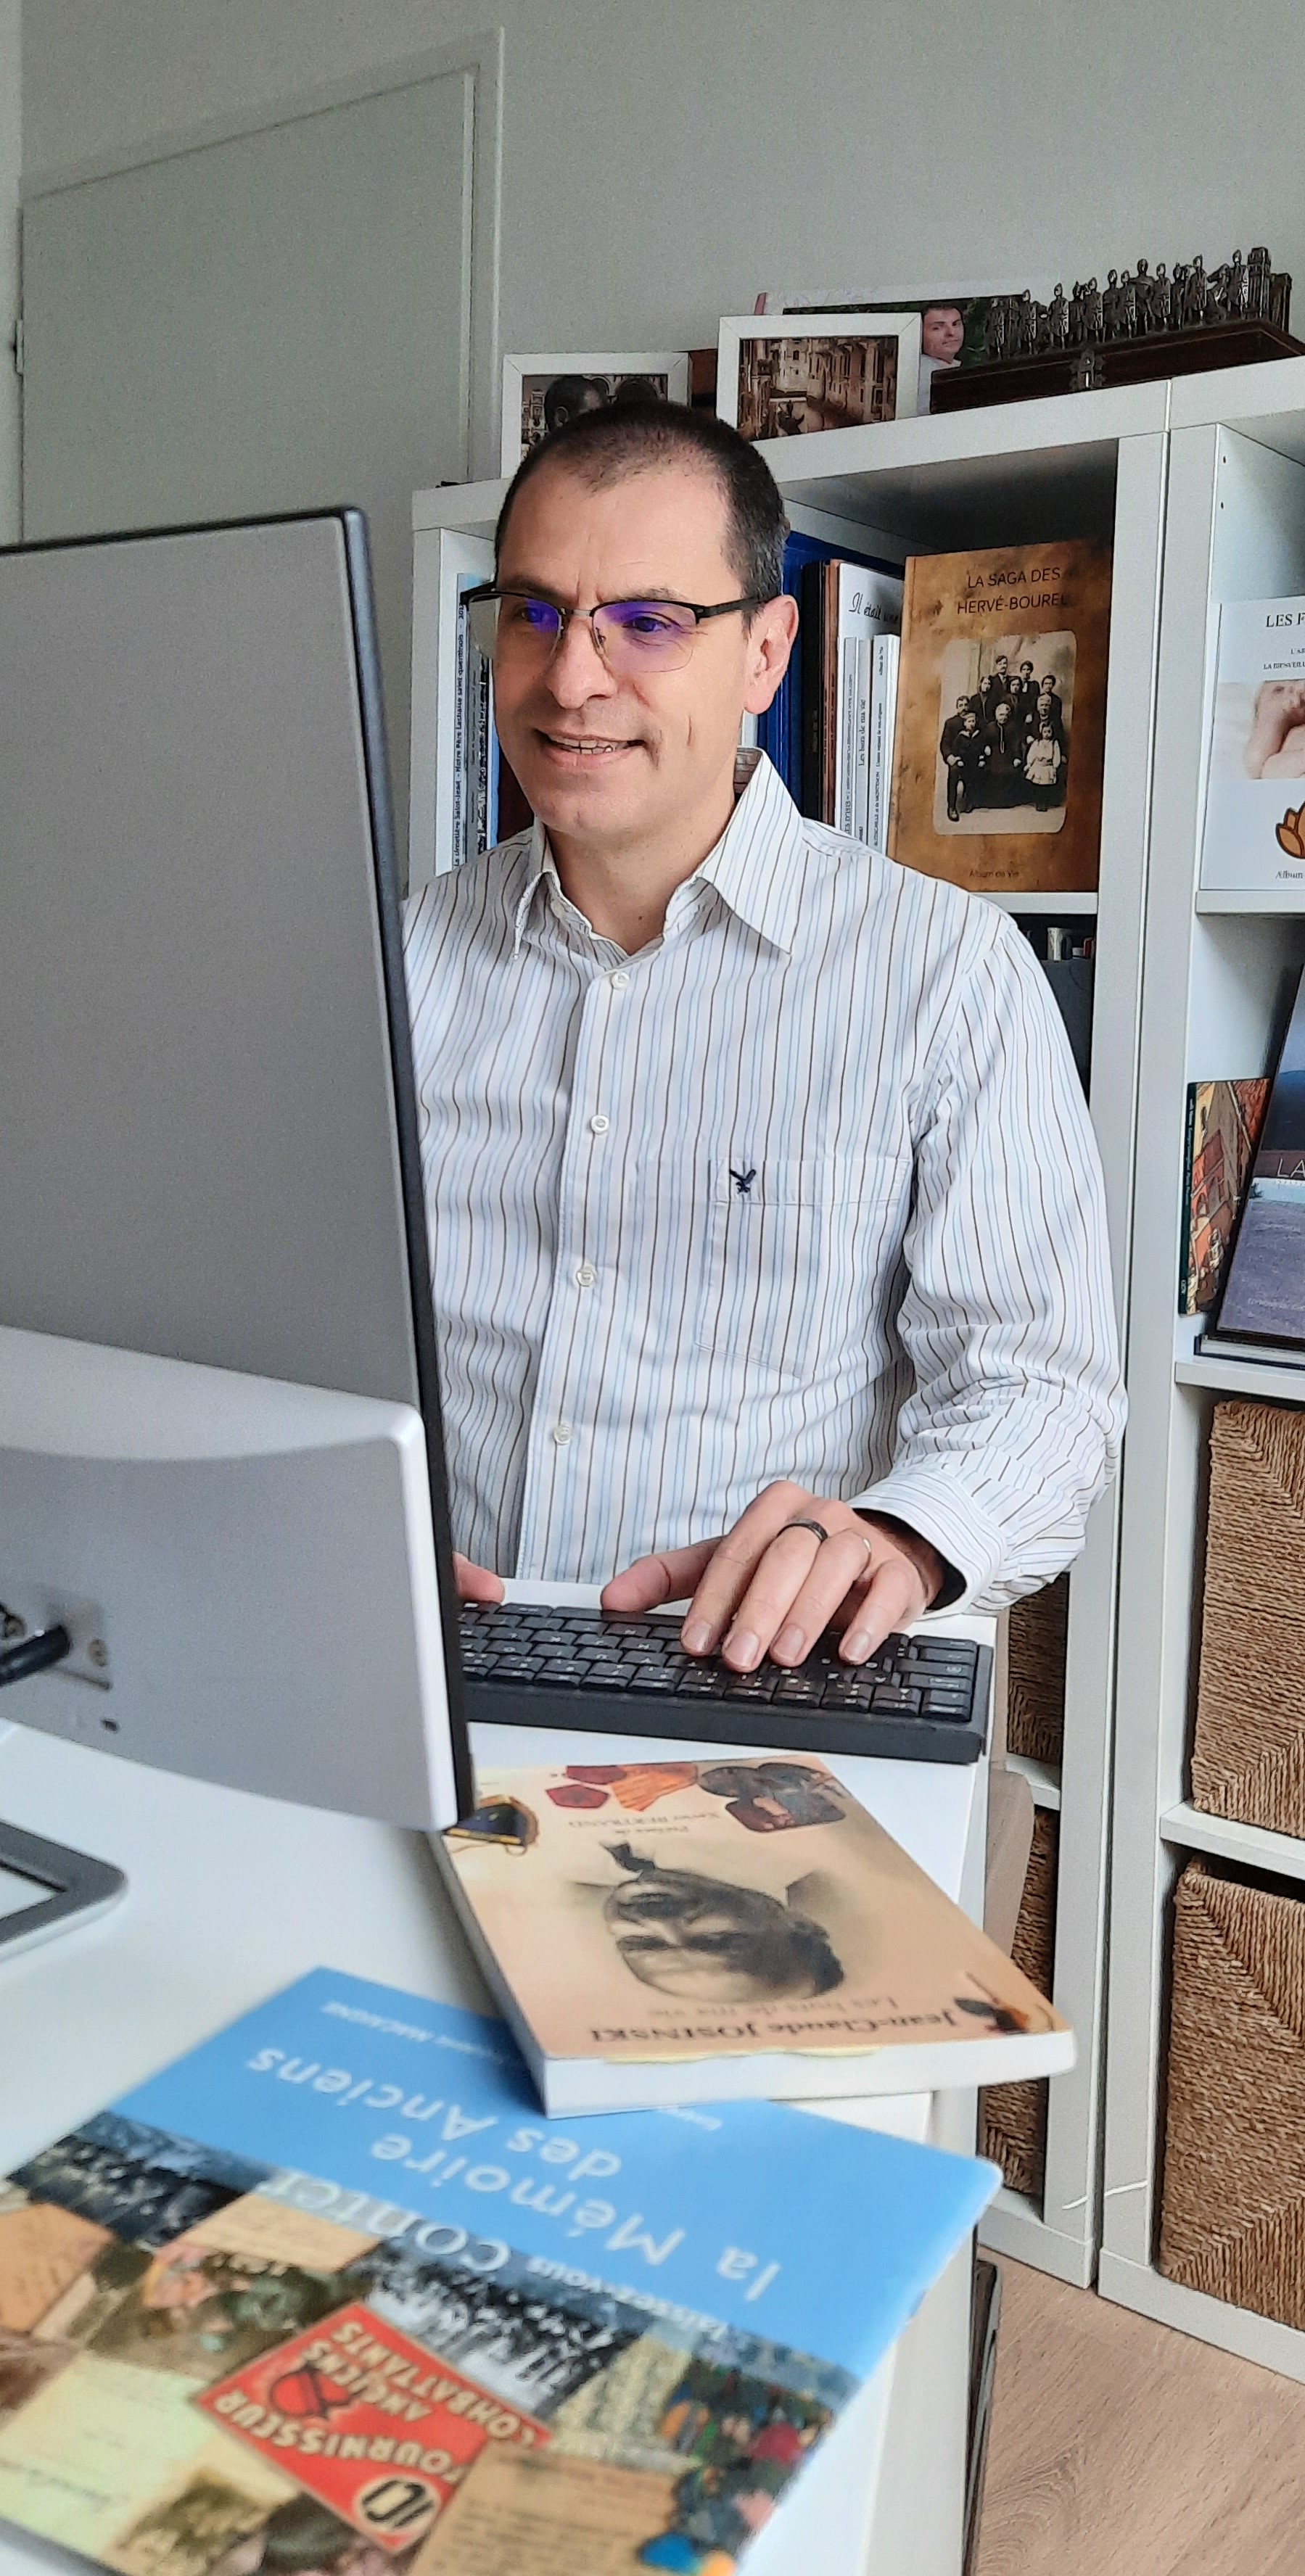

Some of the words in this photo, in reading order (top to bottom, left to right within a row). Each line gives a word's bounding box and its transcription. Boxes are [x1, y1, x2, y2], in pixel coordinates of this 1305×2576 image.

[968, 575, 984, 588] LA
[987, 570, 1026, 587] SAGA
[1031, 567, 1061, 582] DES
[849, 592, 863, 614] Il
[958, 593, 1068, 614] HERVÉ-BOUREL
[1266, 614, 1293, 627] LES
[591, 2020, 760, 2043] JOSINSKI
[767, 2009, 958, 2036] Jean-Claude
[247, 2047, 499, 2142] Anciens
[505, 2127, 622, 2181] des
[370, 2132, 686, 2266] Mémoire
[253, 2168, 511, 2273] conter
[716, 2245, 782, 2302] la
